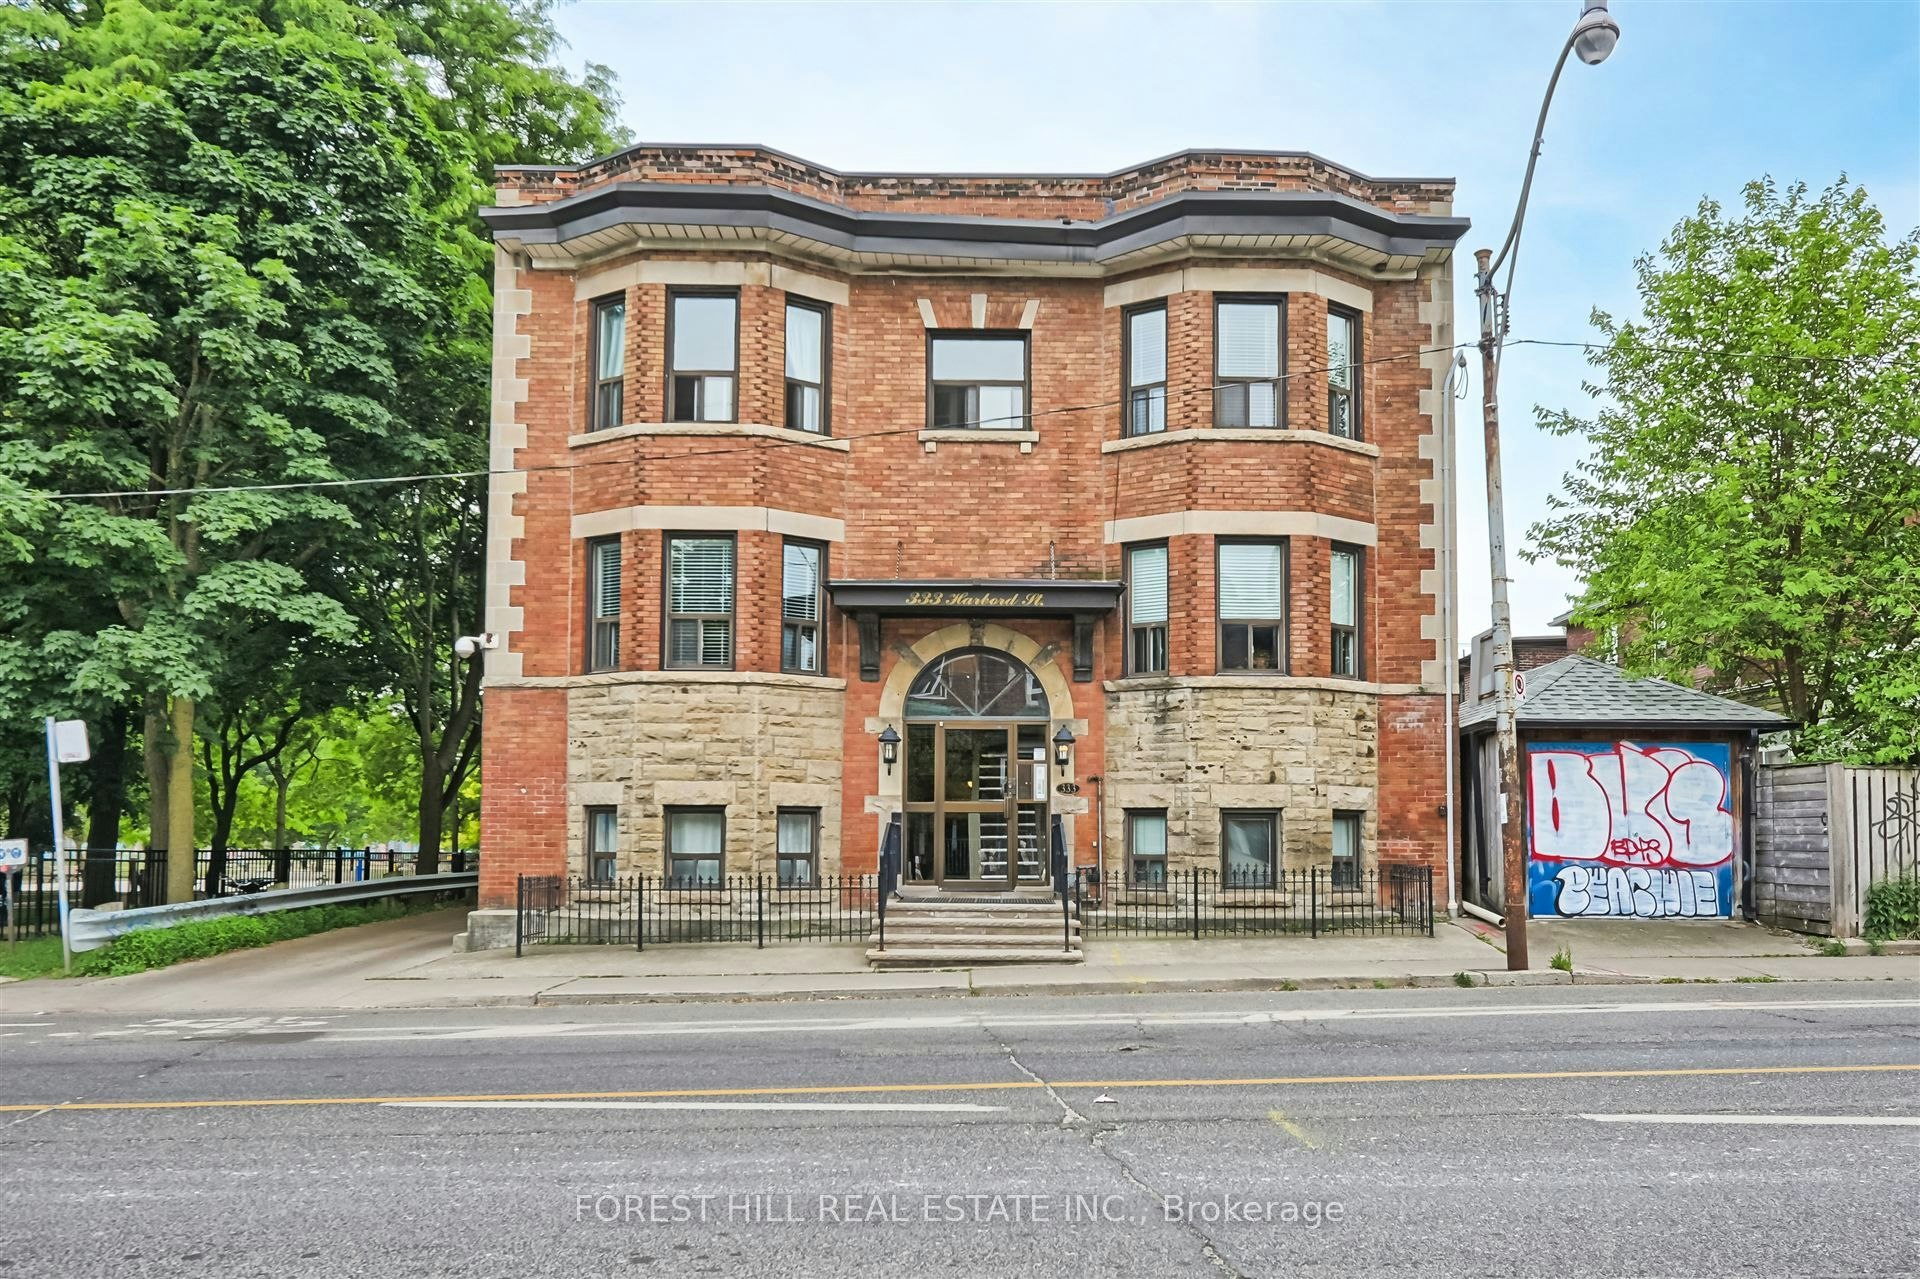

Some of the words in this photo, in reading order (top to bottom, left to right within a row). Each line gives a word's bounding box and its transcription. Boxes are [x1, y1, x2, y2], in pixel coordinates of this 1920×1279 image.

[905, 591, 944, 605] 333
[945, 591, 1019, 606] Harbord
[1021, 592, 1044, 606] St.
[1060, 783, 1077, 793] 333
